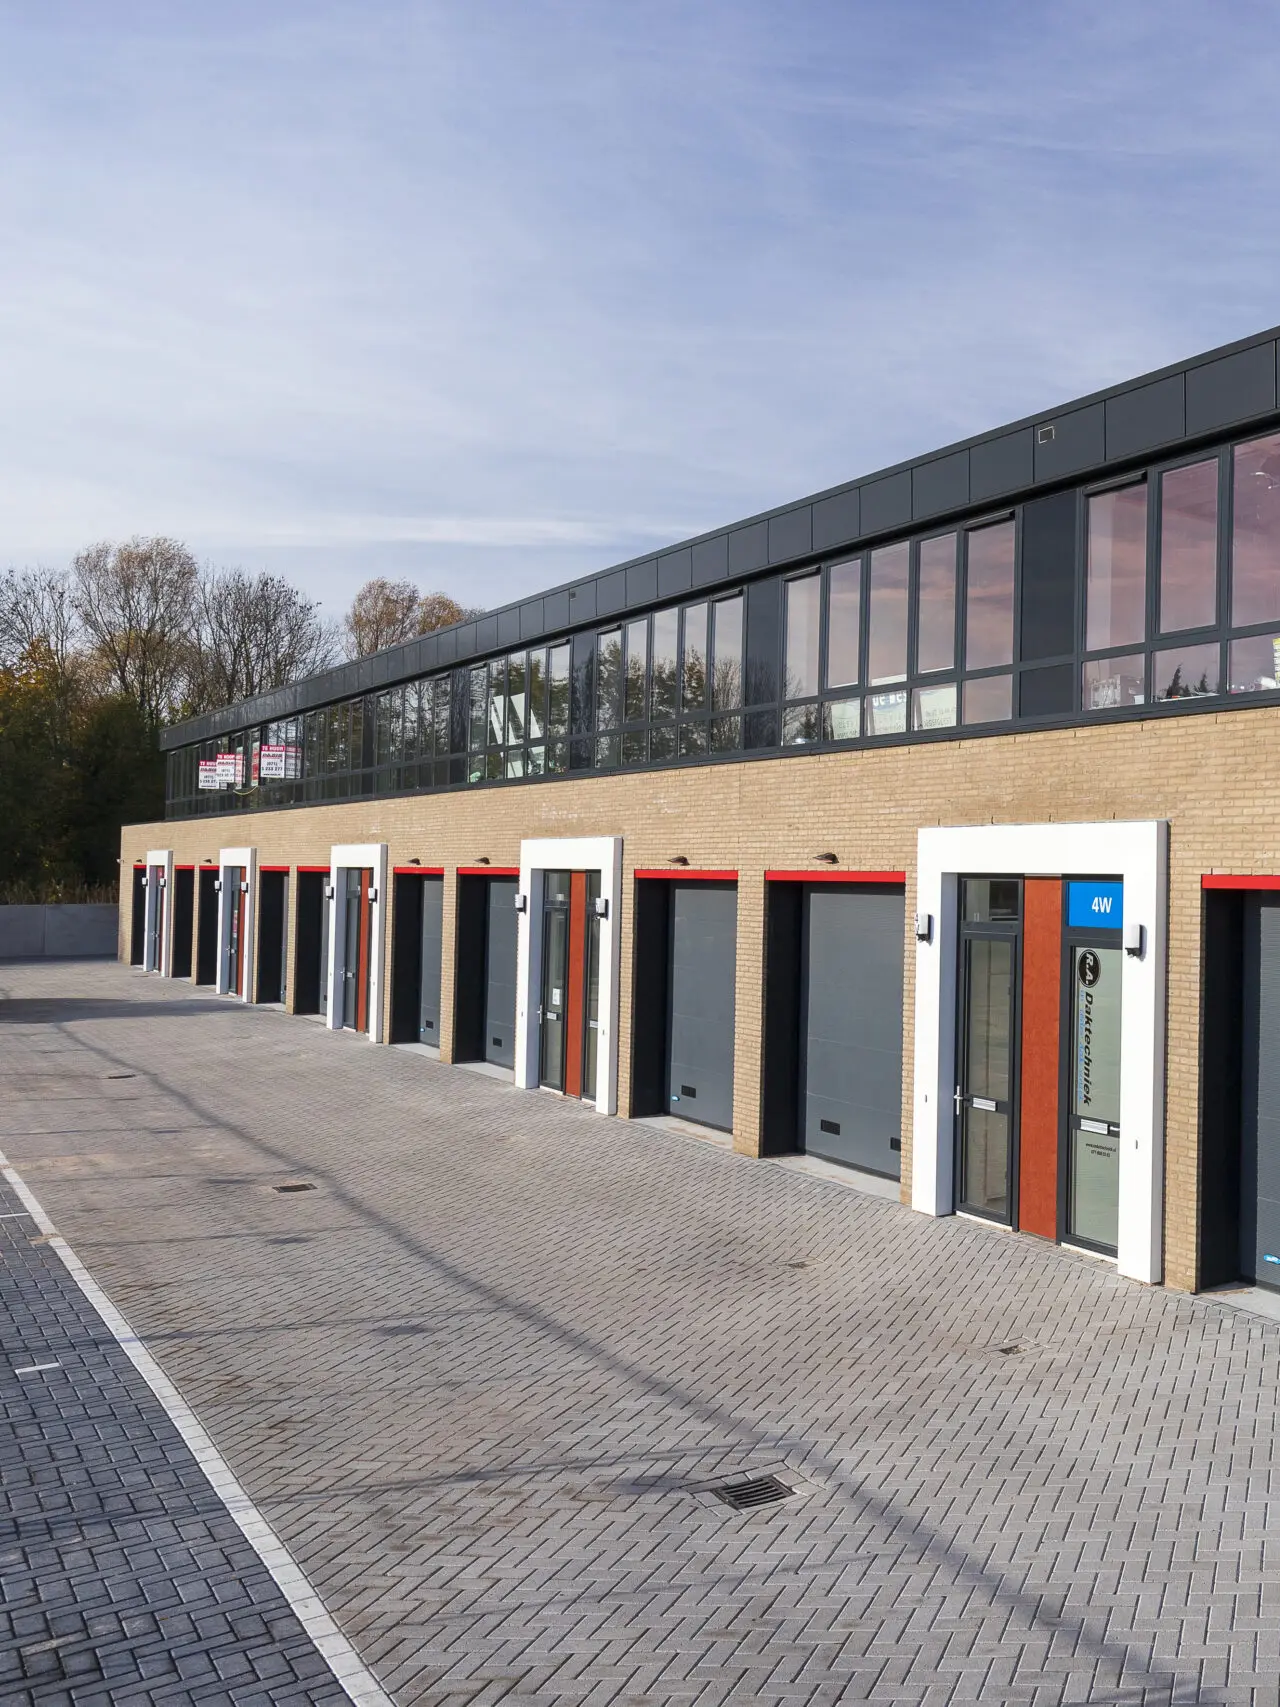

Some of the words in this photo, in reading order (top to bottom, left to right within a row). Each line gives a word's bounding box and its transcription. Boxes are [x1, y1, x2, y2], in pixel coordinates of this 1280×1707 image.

[1091, 896, 1113, 914] 4W
[1085, 952, 1094, 985] R.A.
[1083, 991, 1094, 1107] Daktechniek
